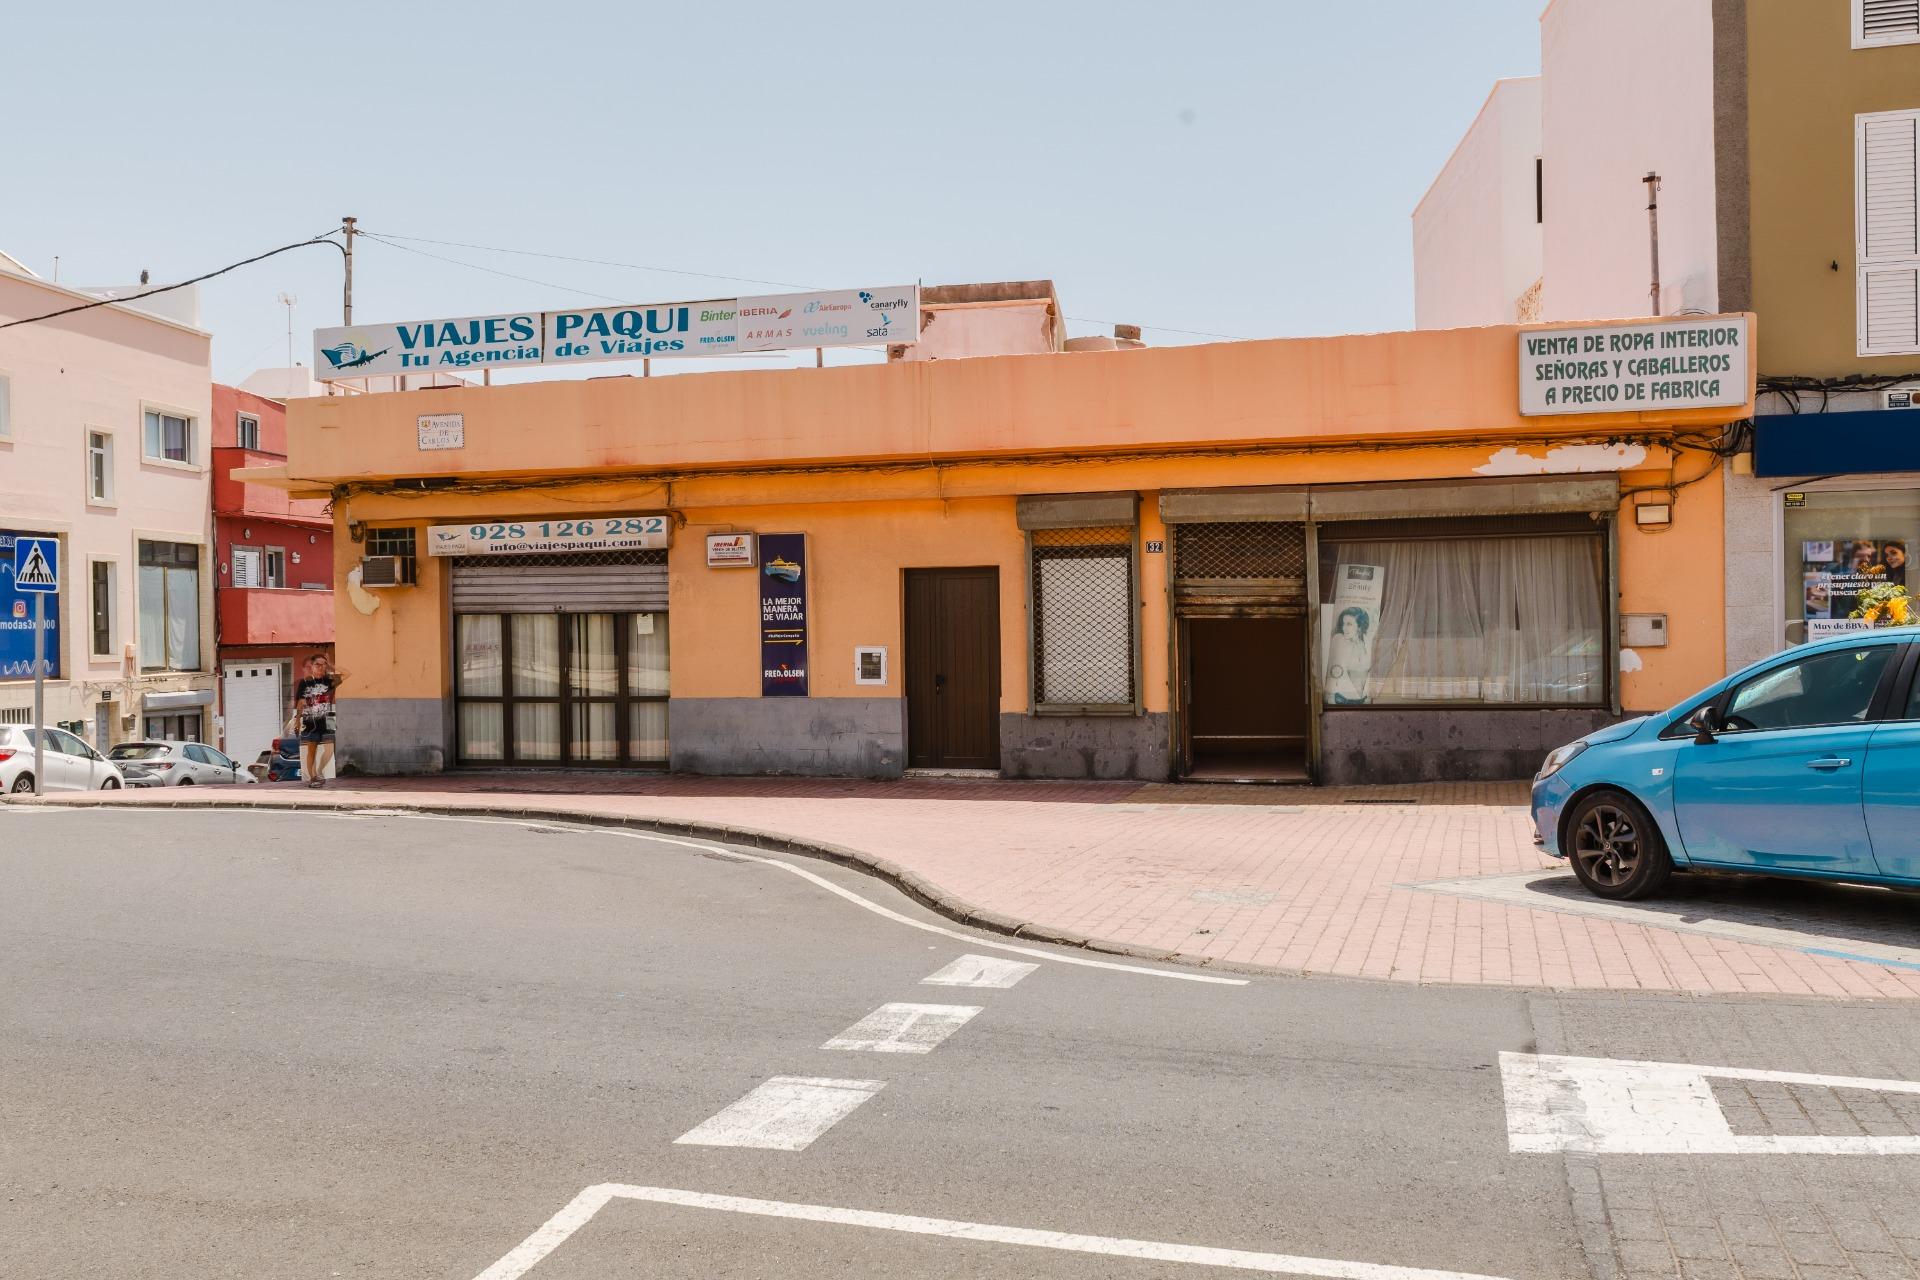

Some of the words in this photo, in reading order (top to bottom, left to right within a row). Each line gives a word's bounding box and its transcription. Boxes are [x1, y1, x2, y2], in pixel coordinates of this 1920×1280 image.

[871, 299, 908, 309] canaryfly
[701, 310, 736, 321] Binter
[740, 307, 777, 317] IBERIA
[396, 316, 535, 350] VIAJES
[555, 307, 689, 340] PAQUI
[802, 321, 848, 338] vueling
[867, 327, 888, 337] sata
[747, 329, 792, 339] ARMAS
[1527, 336, 1578, 356] VENTA
[1583, 335, 1605, 352] DE
[1610, 332, 1654, 353] ROPA
[1661, 327, 1739, 349] INTERIOR
[397, 352, 429, 367] Tu
[438, 345, 540, 367] Agencia
[555, 342, 590, 357] de
[600, 339, 684, 356] Viajes
[1535, 359, 1609, 381] SEÑORAS
[1613, 359, 1623, 379] Y
[1628, 354, 1731, 376] CABALLEROS
[1545, 387, 1556, 406] A
[1562, 384, 1619, 405] PRECIO
[1625, 382, 1646, 400] DE
[1652, 379, 1720, 401] FABRICA
[470, 524, 526, 540] 928
[539, 521, 594, 537] 126
[605, 518, 663, 535] 282
[490, 539, 642, 552] info@viajespaqui.com
[1149, 542, 1160, 552] 32
[1850, 572, 1874, 580] claro
[1817, 581, 1870, 590] presupuesto
[762, 597, 773, 605] LA
[775, 597, 802, 605] MEJOR
[763, 605, 798, 613] MANERA
[763, 613, 774, 621] DE
[776, 612, 803, 620] VIAJAR
[1814, 623, 1832, 631] Muy
[764, 669, 783, 678] FRED.
[784, 669, 805, 678] OLSEN
